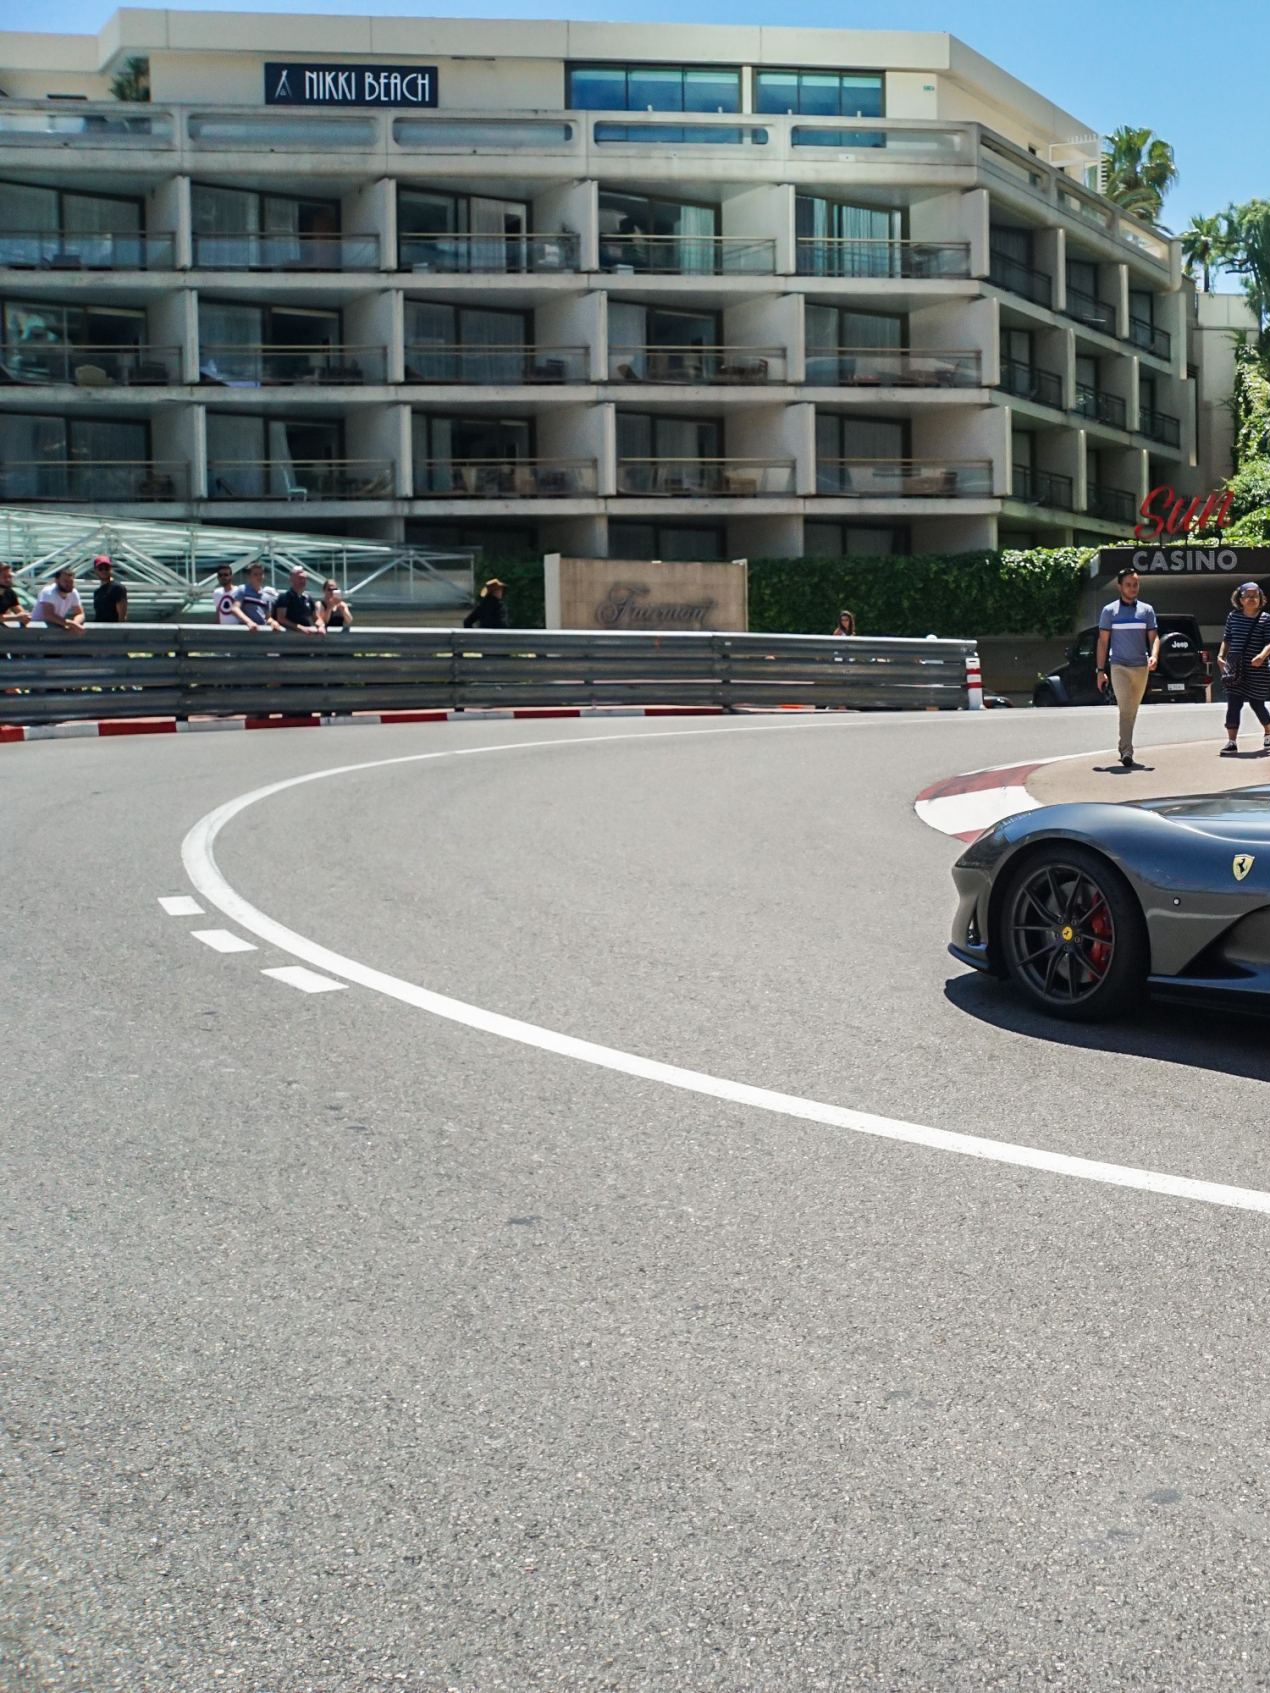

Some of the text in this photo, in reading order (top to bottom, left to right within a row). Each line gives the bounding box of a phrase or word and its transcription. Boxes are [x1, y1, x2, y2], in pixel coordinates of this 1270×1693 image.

[305, 70, 430, 101] NIKKI BEACH
[1134, 485, 1235, 540] Sun
[1132, 549, 1238, 572] CASINO
[1171, 640, 1189, 649] Jeep
